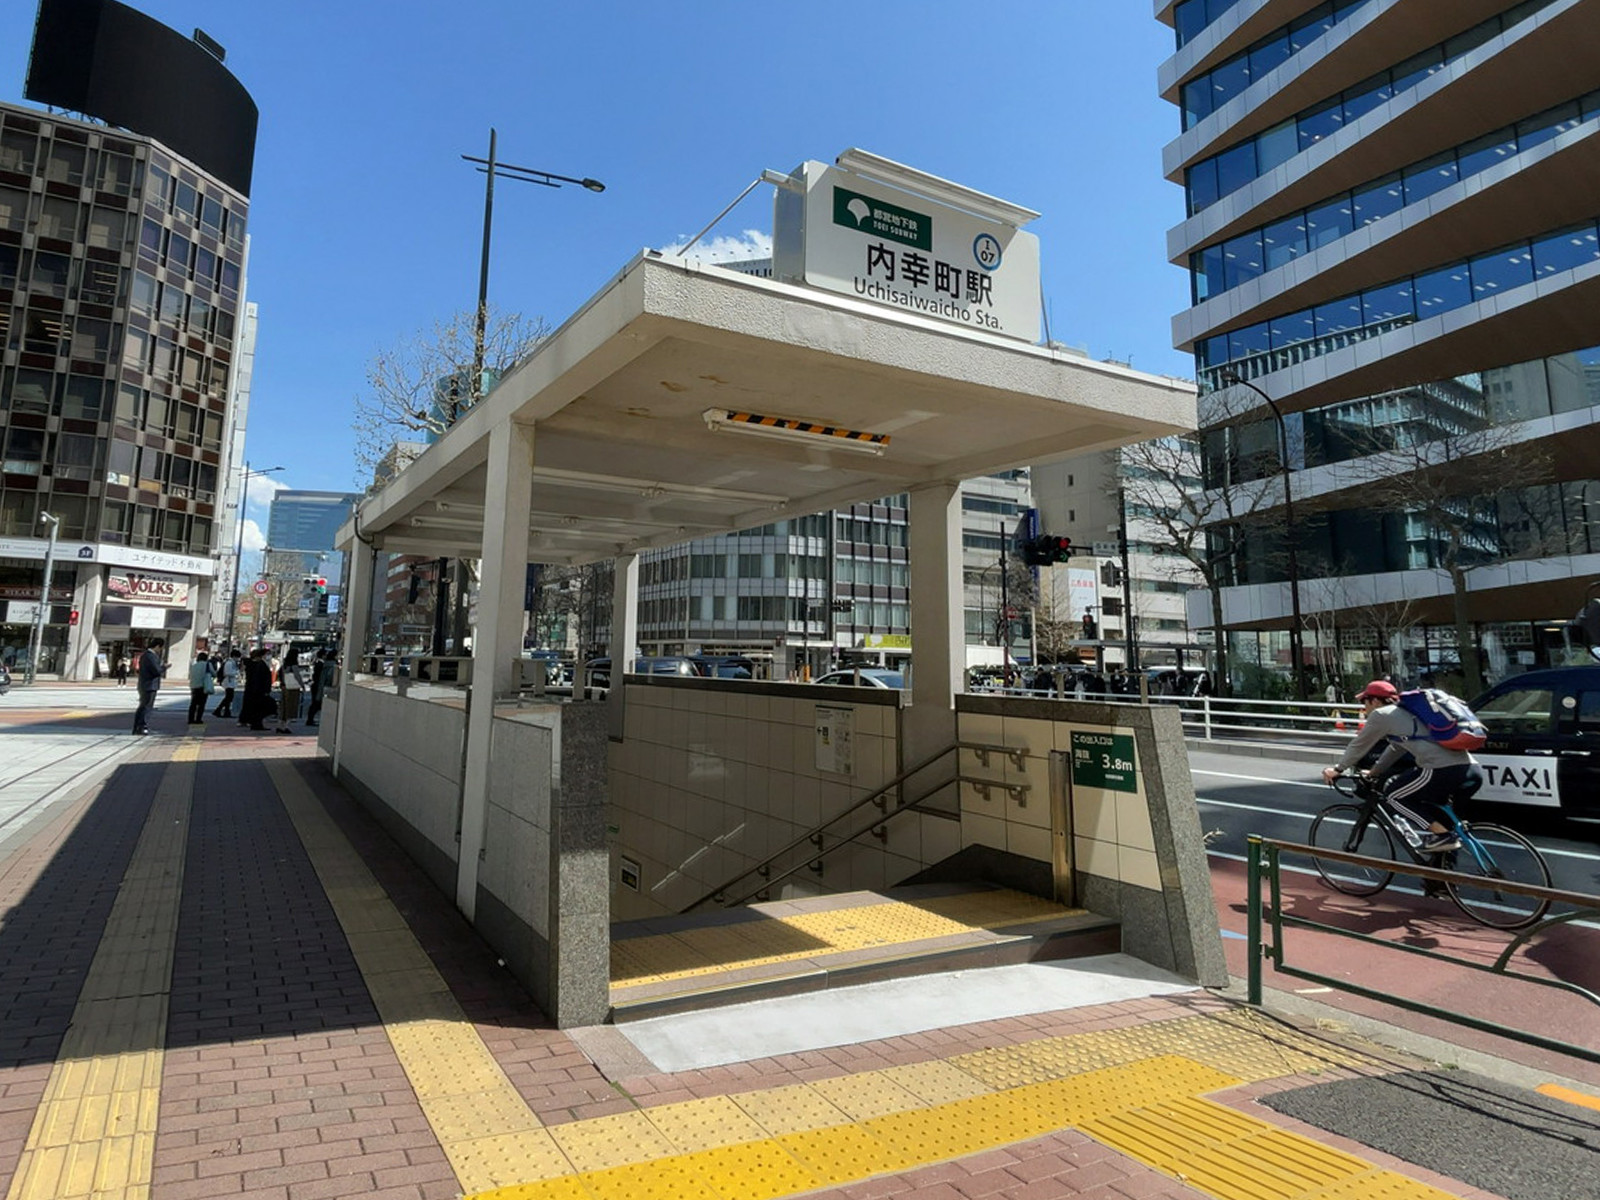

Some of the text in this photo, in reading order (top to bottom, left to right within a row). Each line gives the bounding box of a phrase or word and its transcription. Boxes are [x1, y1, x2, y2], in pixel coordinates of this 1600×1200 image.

[873, 208, 918, 231] 都営地下鉄
[980, 250, 995, 264] 07
[867, 243, 993, 307] 内幸町駅
[854, 276, 1003, 330] Uchisaiwaicho Sta.
[125, 573, 174, 595] VOLKS
[1102, 754, 1133, 771] 3.8m
[1481, 765, 1551, 790] TAXI
